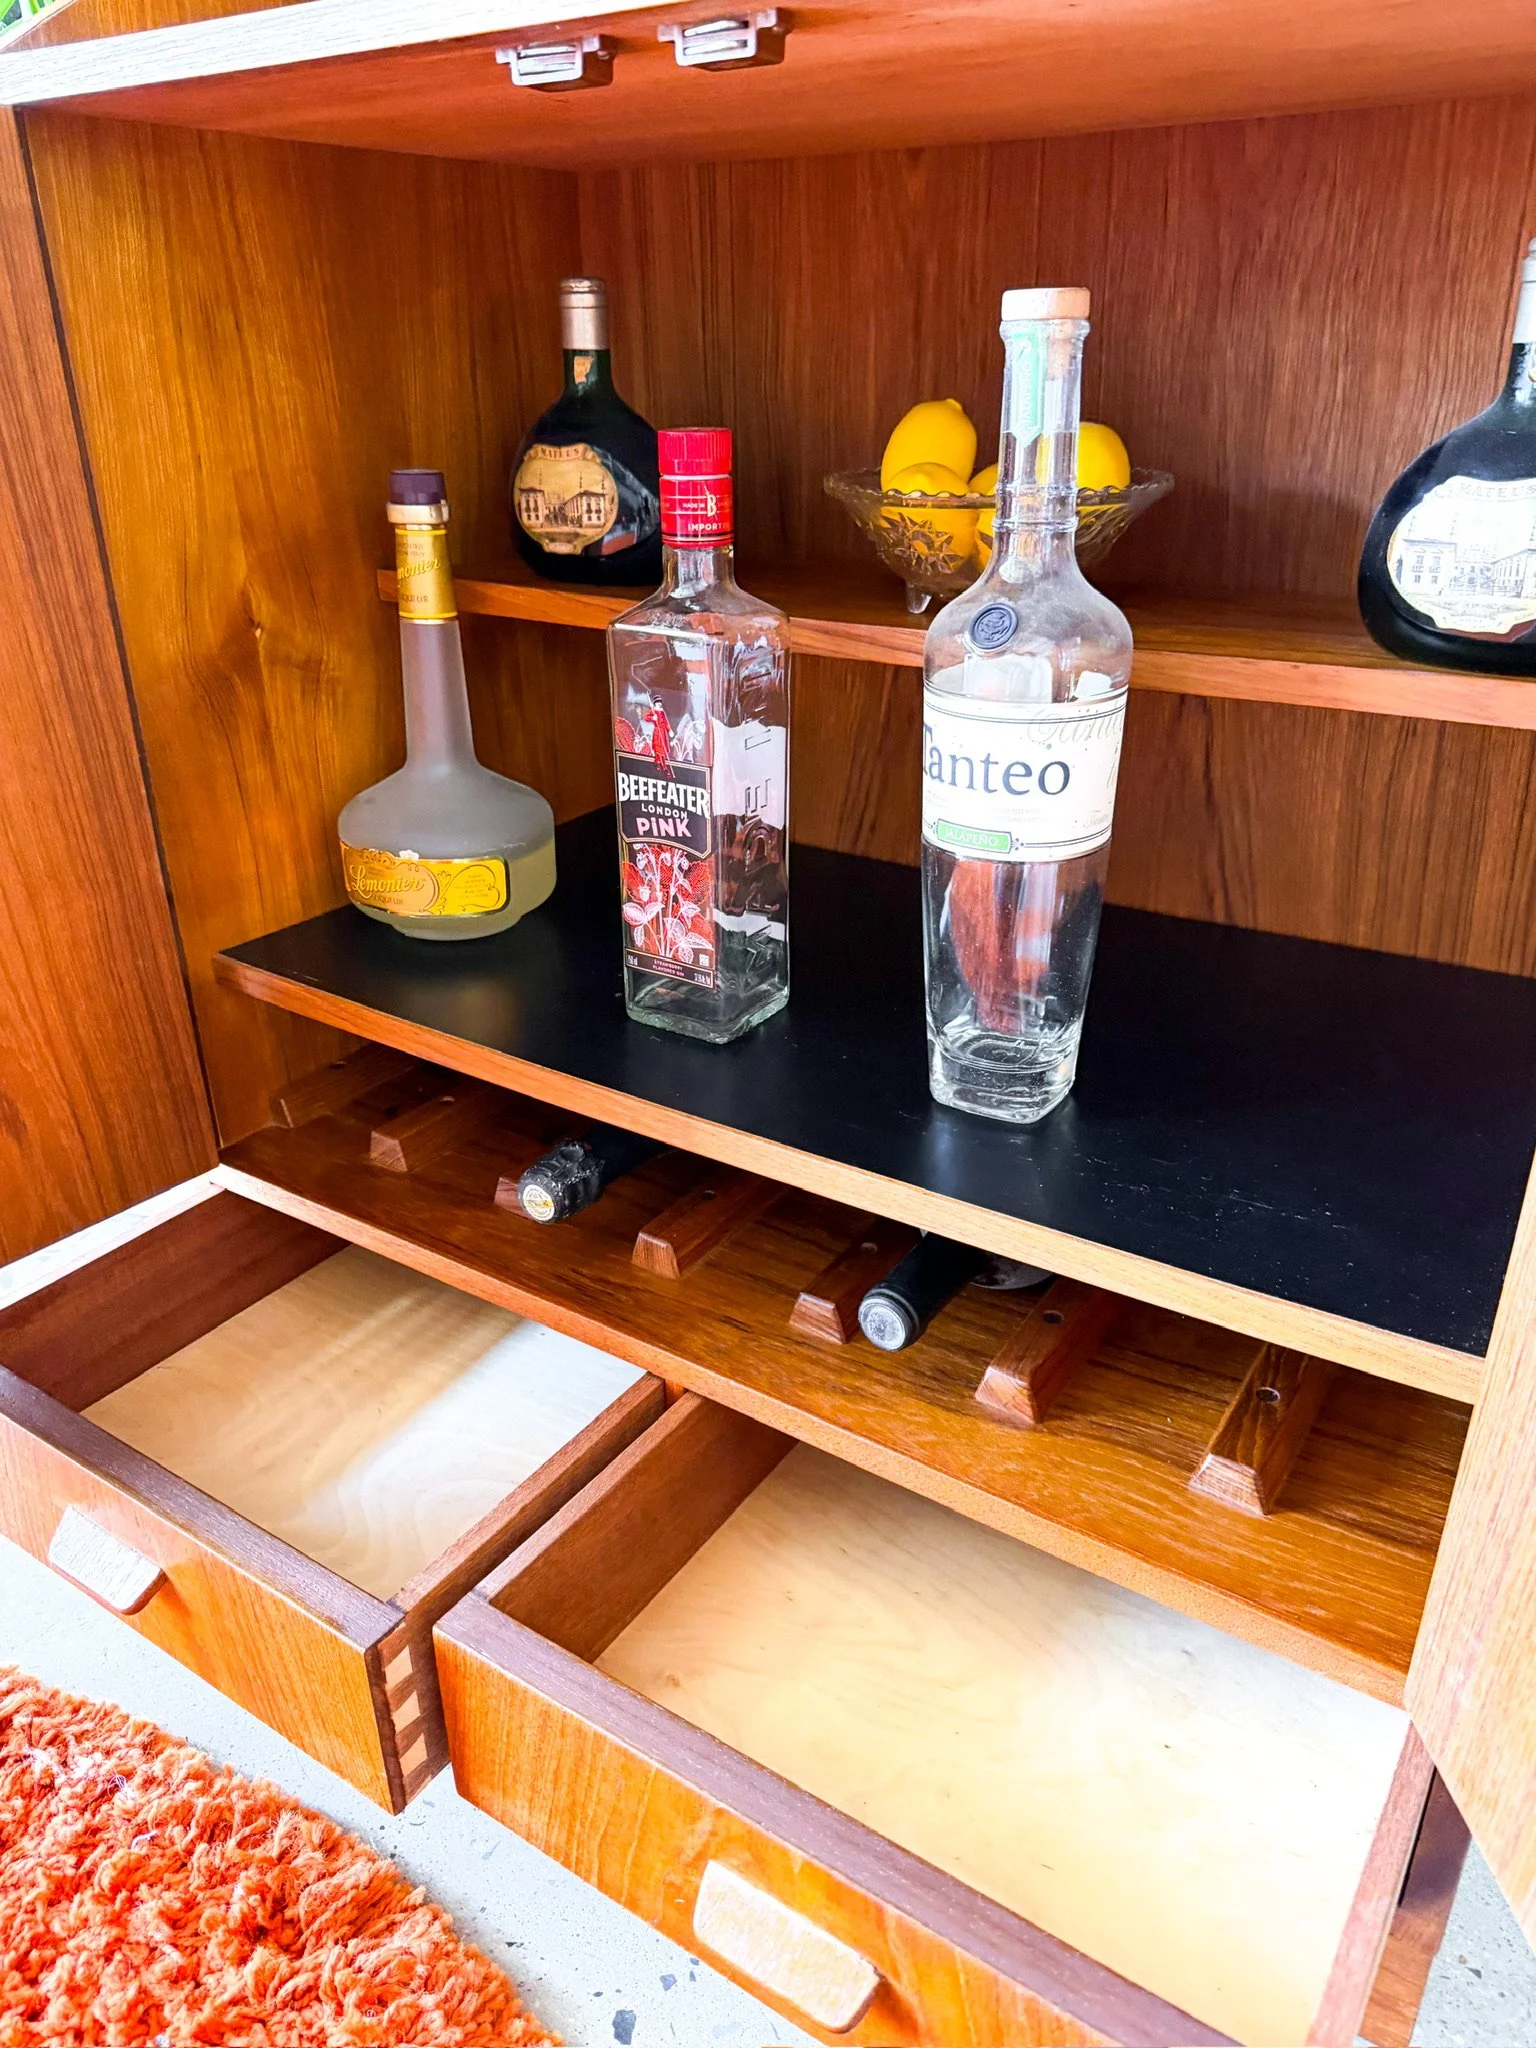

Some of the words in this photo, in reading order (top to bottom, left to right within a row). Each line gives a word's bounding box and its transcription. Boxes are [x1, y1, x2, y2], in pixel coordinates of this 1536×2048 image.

[1460, 481, 1536, 498] MATEUS
[617, 771, 710, 820] BEEFEATER
[641, 803, 687, 820] LONDON
[349, 865, 425, 899] Lemonier
